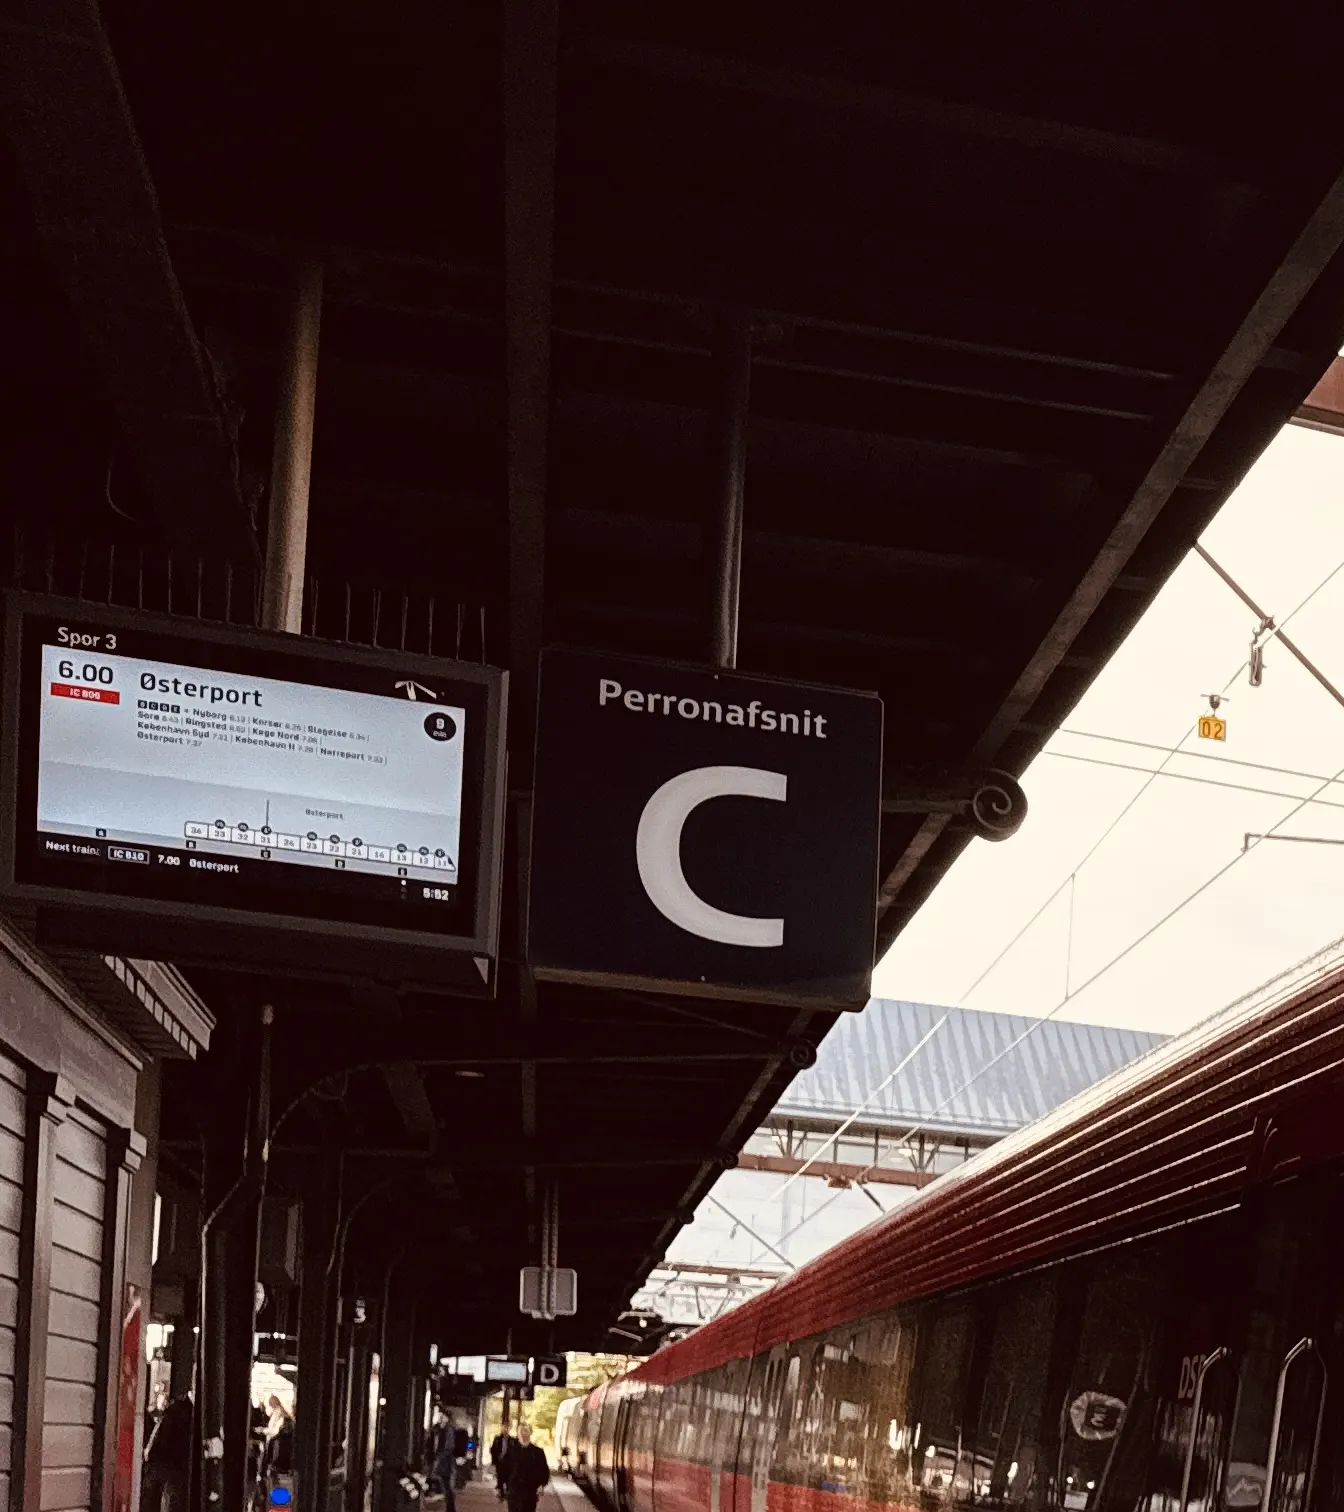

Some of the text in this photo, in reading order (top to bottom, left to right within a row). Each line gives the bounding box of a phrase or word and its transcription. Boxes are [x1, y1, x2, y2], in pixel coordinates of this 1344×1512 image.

[57, 626, 117, 650] Spor 3
[58, 660, 114, 685] 6.00
[139, 672, 264, 708] Østerport
[599, 678, 828, 739] Perronafsnit
[1202, 720, 1223, 741] 02
[45, 839, 70, 853] Next
[157, 854, 181, 866] 7.00
[635, 764, 788, 948] C
[540, 1363, 560, 1384] D
